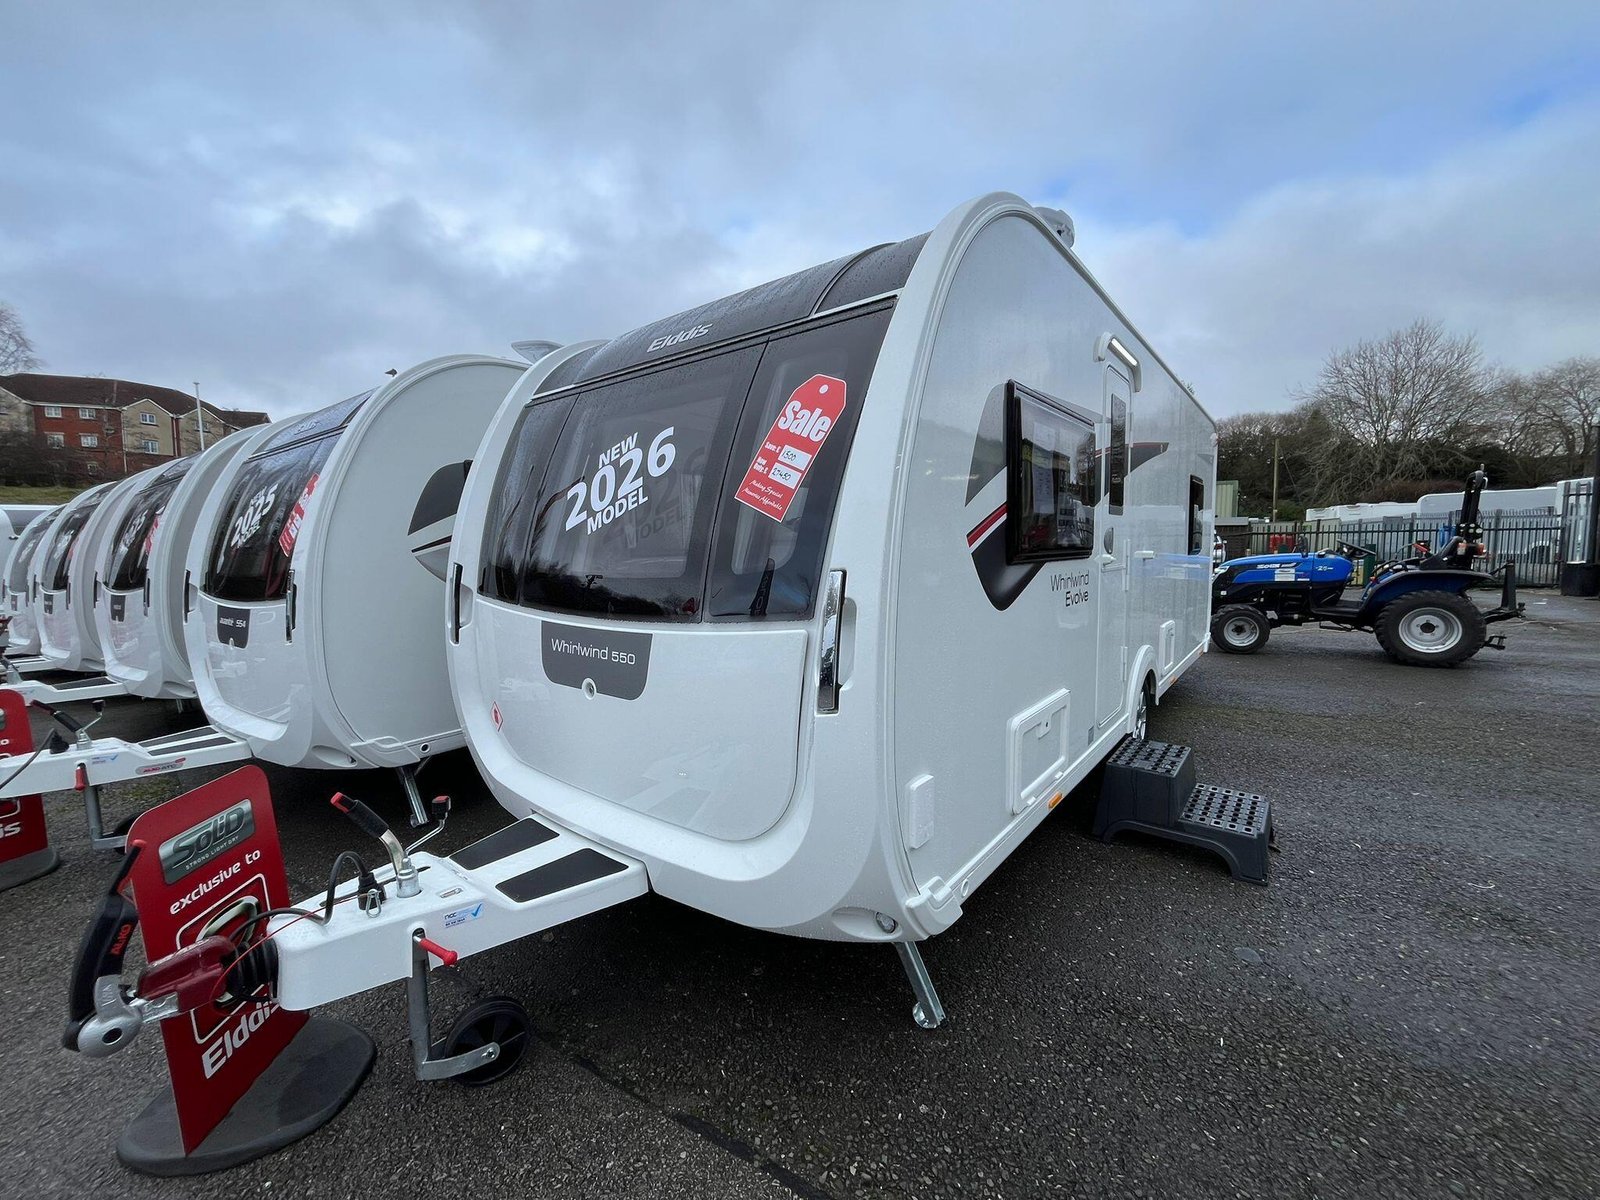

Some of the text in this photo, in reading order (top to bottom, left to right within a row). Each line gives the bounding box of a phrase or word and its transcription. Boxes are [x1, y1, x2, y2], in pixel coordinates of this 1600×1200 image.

[646, 323, 713, 353] Elddis
[778, 400, 832, 442] Sale
[598, 432, 638, 469] NEW
[781, 450, 797, 461] 1500
[565, 426, 676, 532] 2026
[772, 467, 791, 481] 27450
[765, 486, 783, 499] Special
[230, 482, 279, 547] 2025
[587, 487, 648, 535] MODEL
[1050, 569, 1090, 592] Whirlwind
[1065, 589, 1089, 607] Evolve
[551, 638, 636, 665] Whirlwind 550
[185, 835, 239, 870] STRONG LIGHT DRY
[169, 849, 261, 915] exclusive to
